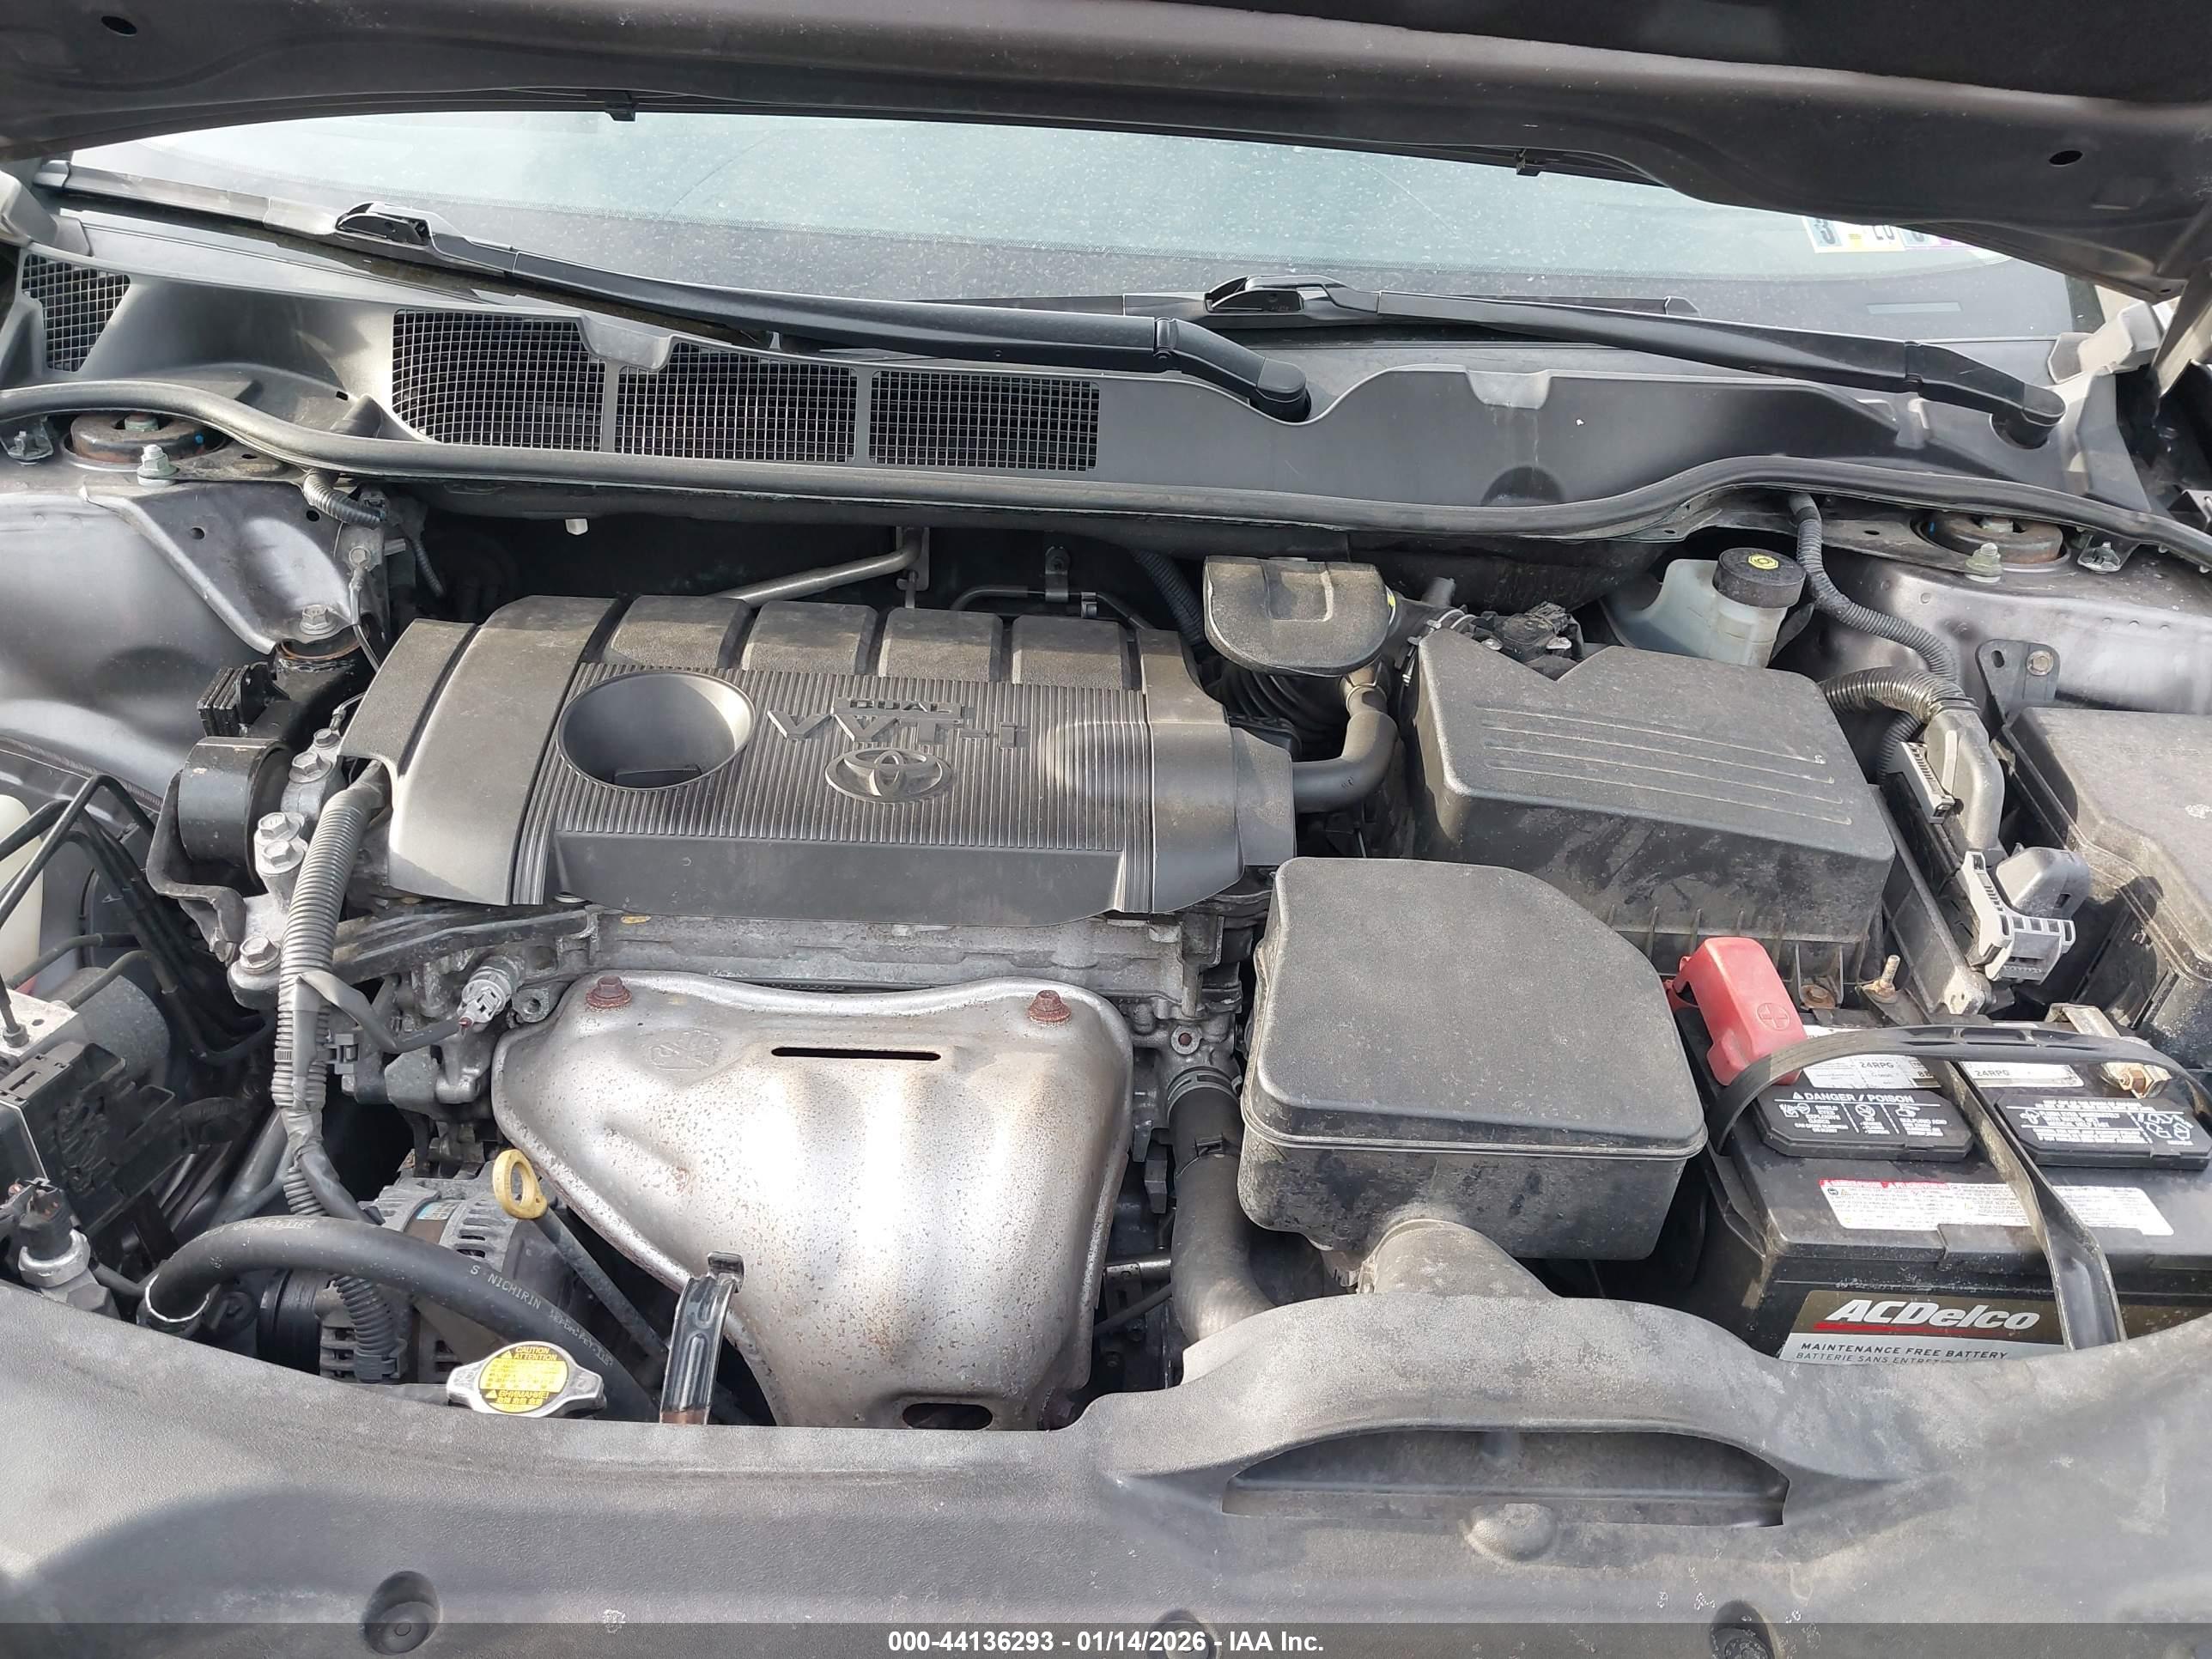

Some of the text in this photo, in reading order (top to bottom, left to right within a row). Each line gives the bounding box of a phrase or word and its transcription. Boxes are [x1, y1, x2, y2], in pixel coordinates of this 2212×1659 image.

[1859, 1060, 1895, 1070] 24RPG
[1974, 1069, 2011, 1078] 24RPG
[1803, 1091, 1855, 1103] DANGER
[1867, 1094, 1915, 1104] POISON
[470, 1264, 542, 1310] S NICHIRIN
[1825, 1298, 2041, 1330] ACDelco
[515, 1346, 550, 1354] CAUTION
[1801, 1342, 2008, 1360] MAINTENANCE FREE BATTERY
[513, 1353, 558, 1362] ATTENTION
[1796, 1352, 1856, 1363] BATTERIE
[1857, 1355, 1891, 1364] SANS
